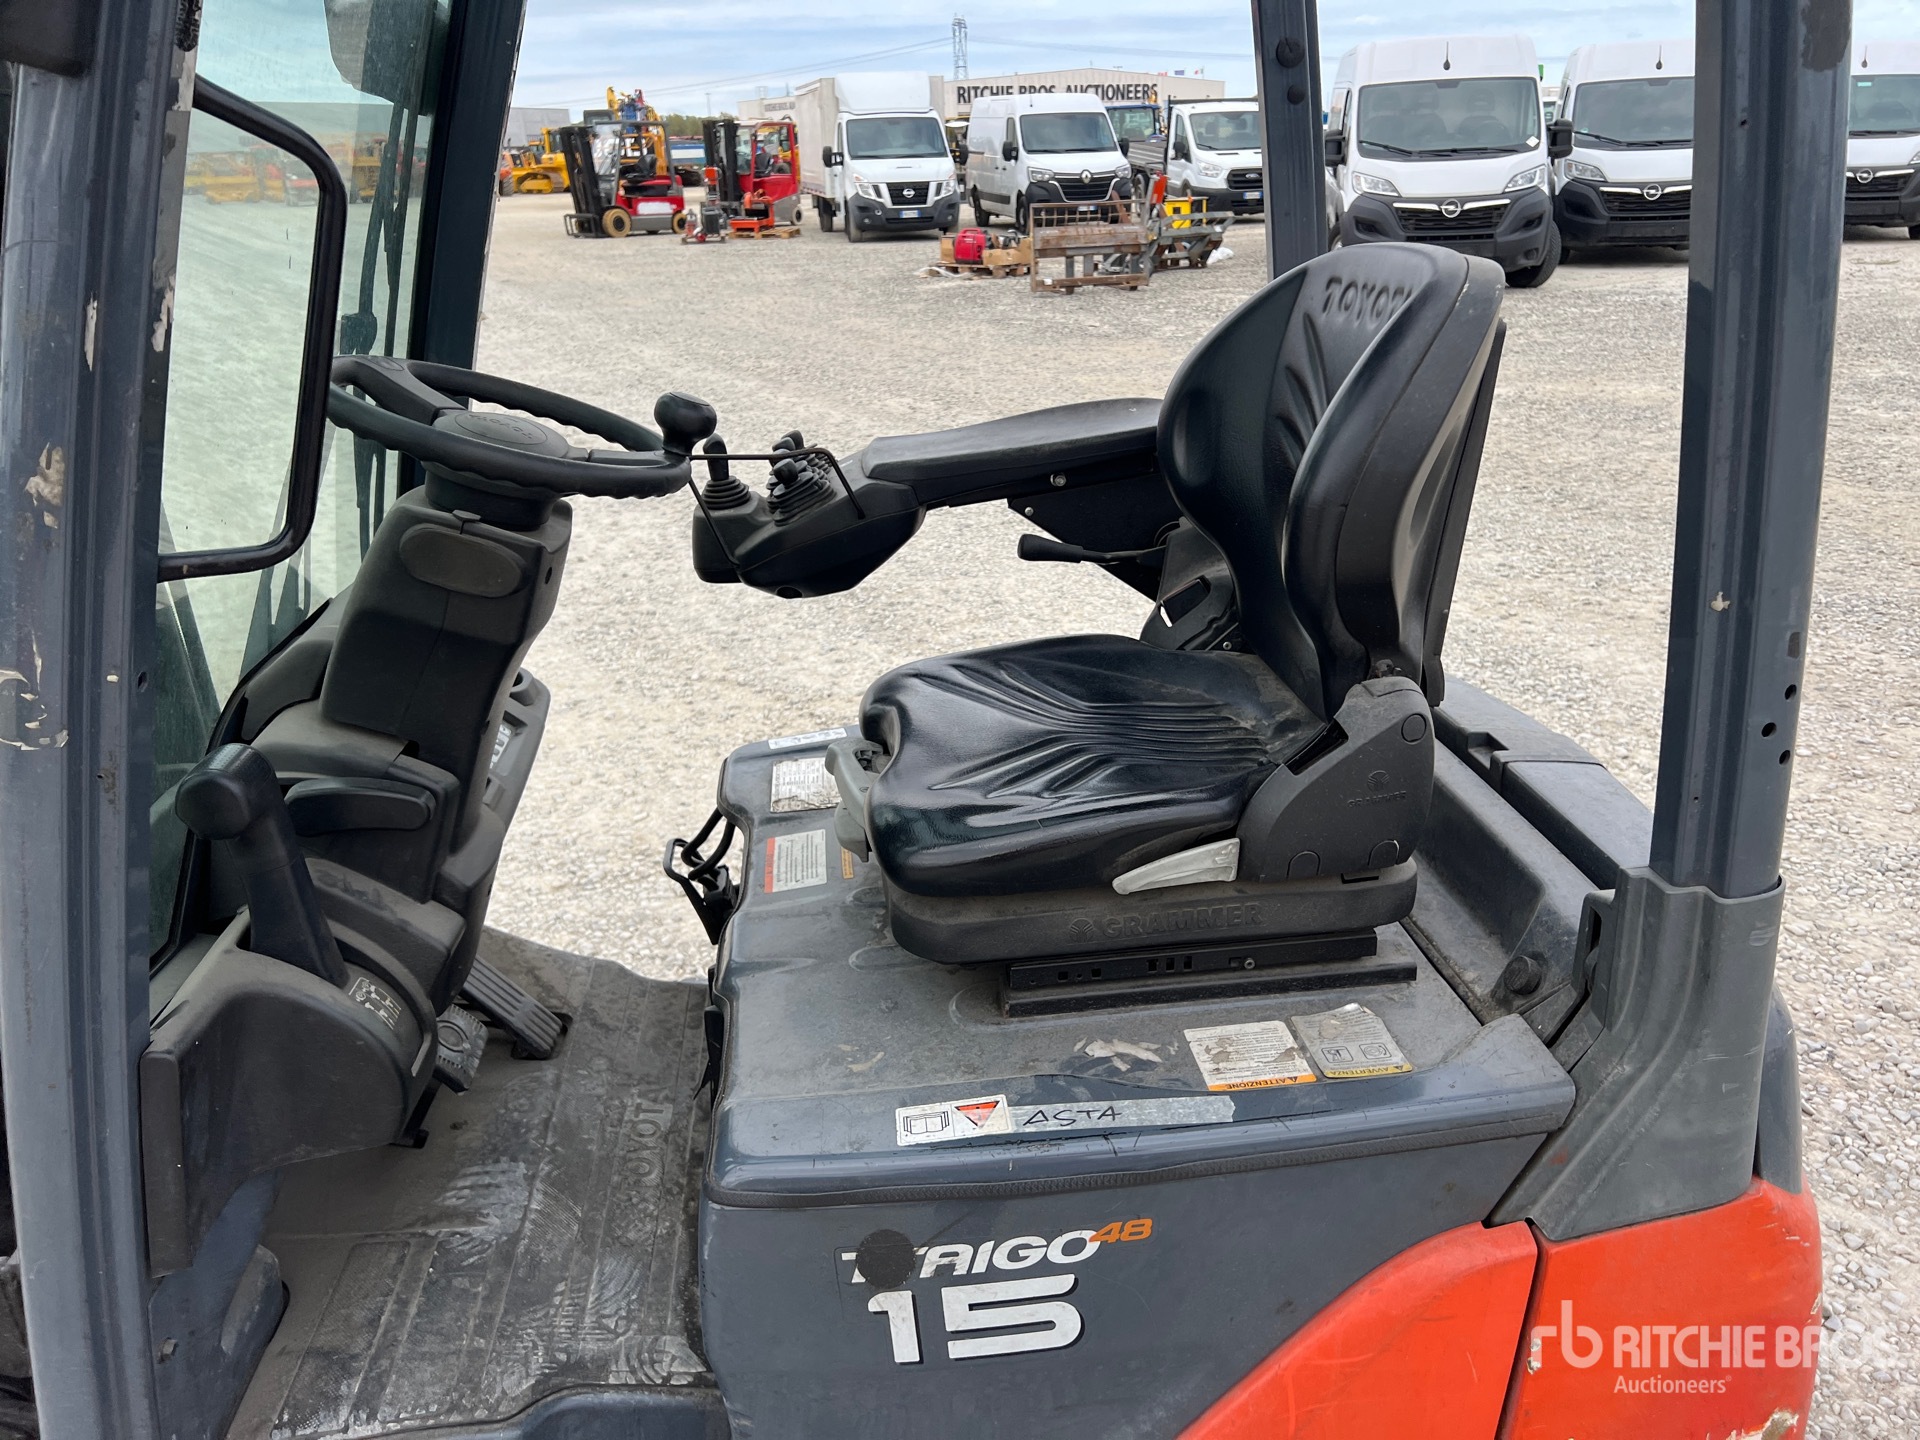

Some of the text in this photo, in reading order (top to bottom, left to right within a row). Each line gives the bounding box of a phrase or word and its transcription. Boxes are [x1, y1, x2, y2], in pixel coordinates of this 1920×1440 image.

[1322, 275, 1413, 324] TOYOT
[1102, 902, 1263, 938] GRAMMER
[1225, 1077, 1287, 1090] ATTENZIONE
[1329, 1066, 1389, 1076] AVVERTENZA
[1022, 1105, 1122, 1127] ASTA
[842, 1229, 1101, 1284] AIGO
[867, 1273, 1081, 1364] 15
